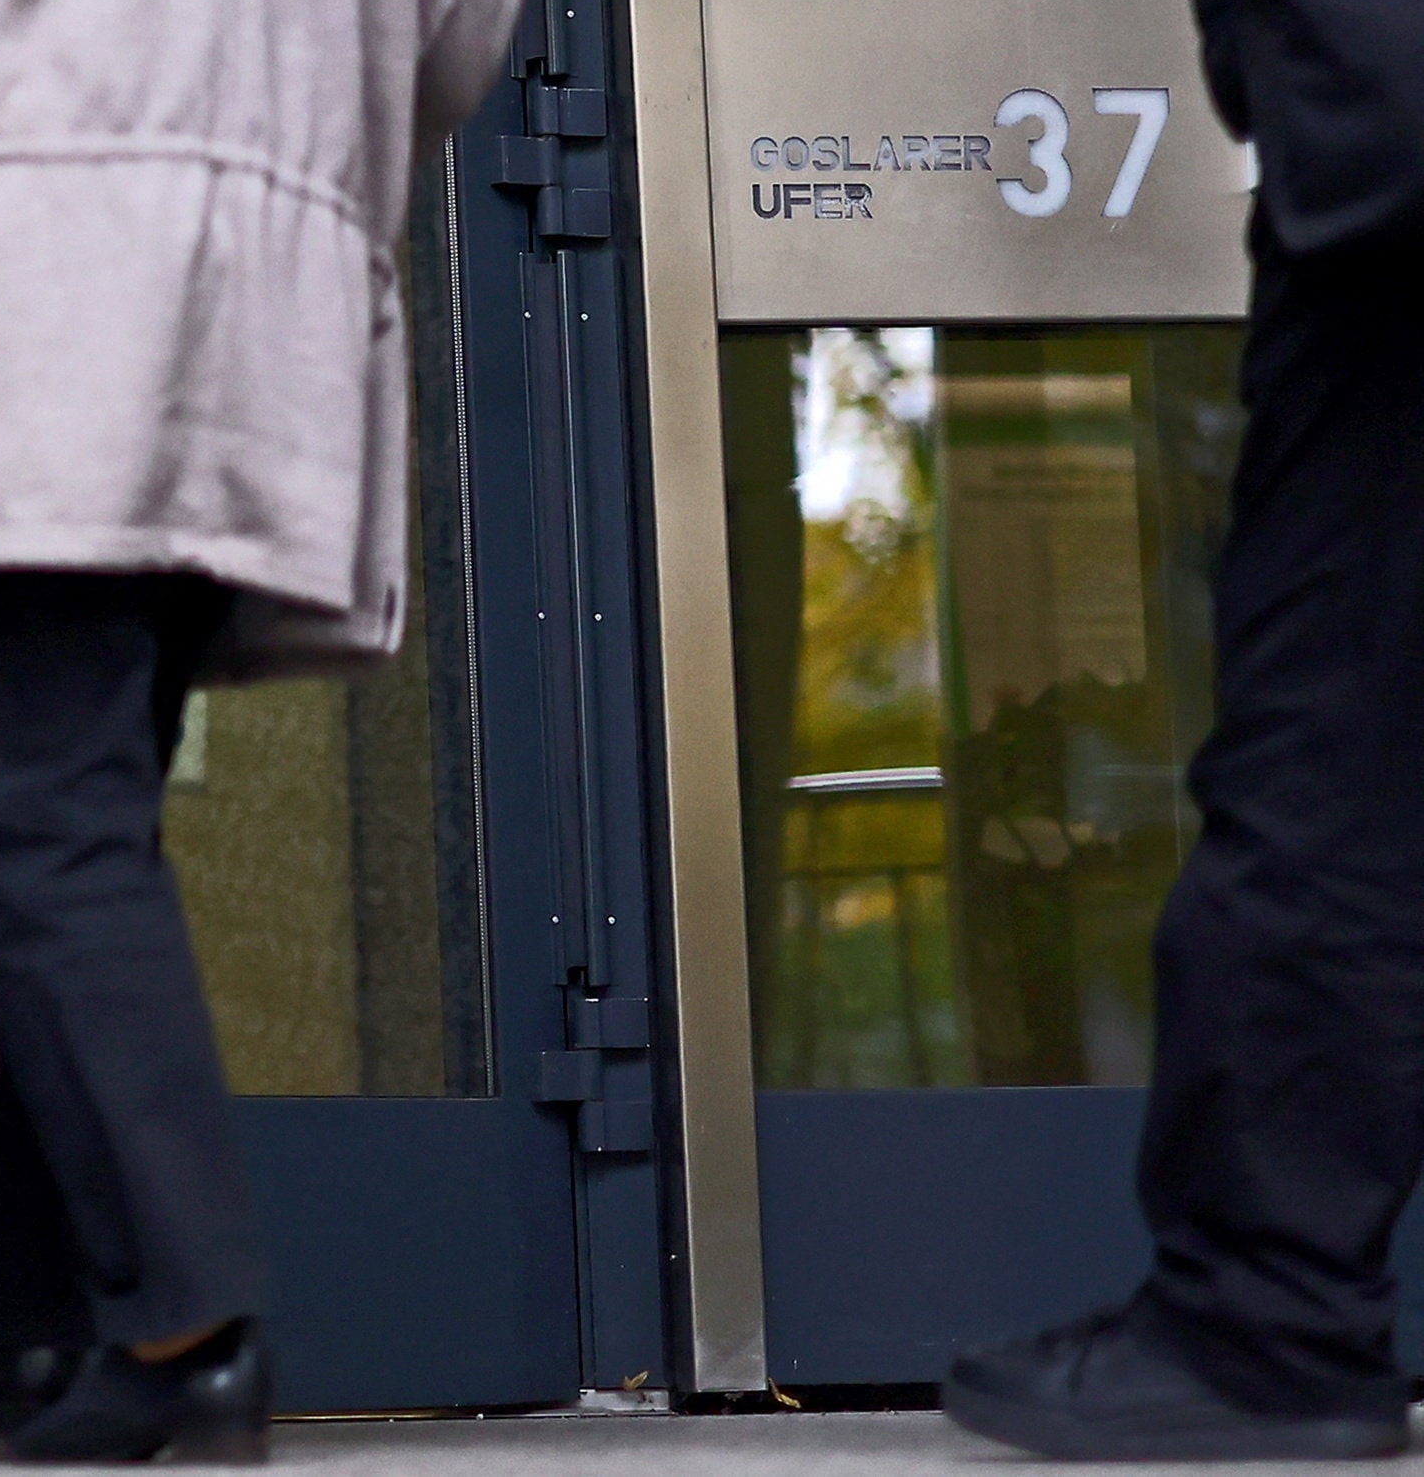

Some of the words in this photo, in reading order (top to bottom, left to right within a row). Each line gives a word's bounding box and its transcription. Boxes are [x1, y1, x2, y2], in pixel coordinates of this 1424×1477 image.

[750, 134, 993, 172] GOSLARER
[993, 86, 1171, 219] 37
[751, 183, 874, 220] UFER
